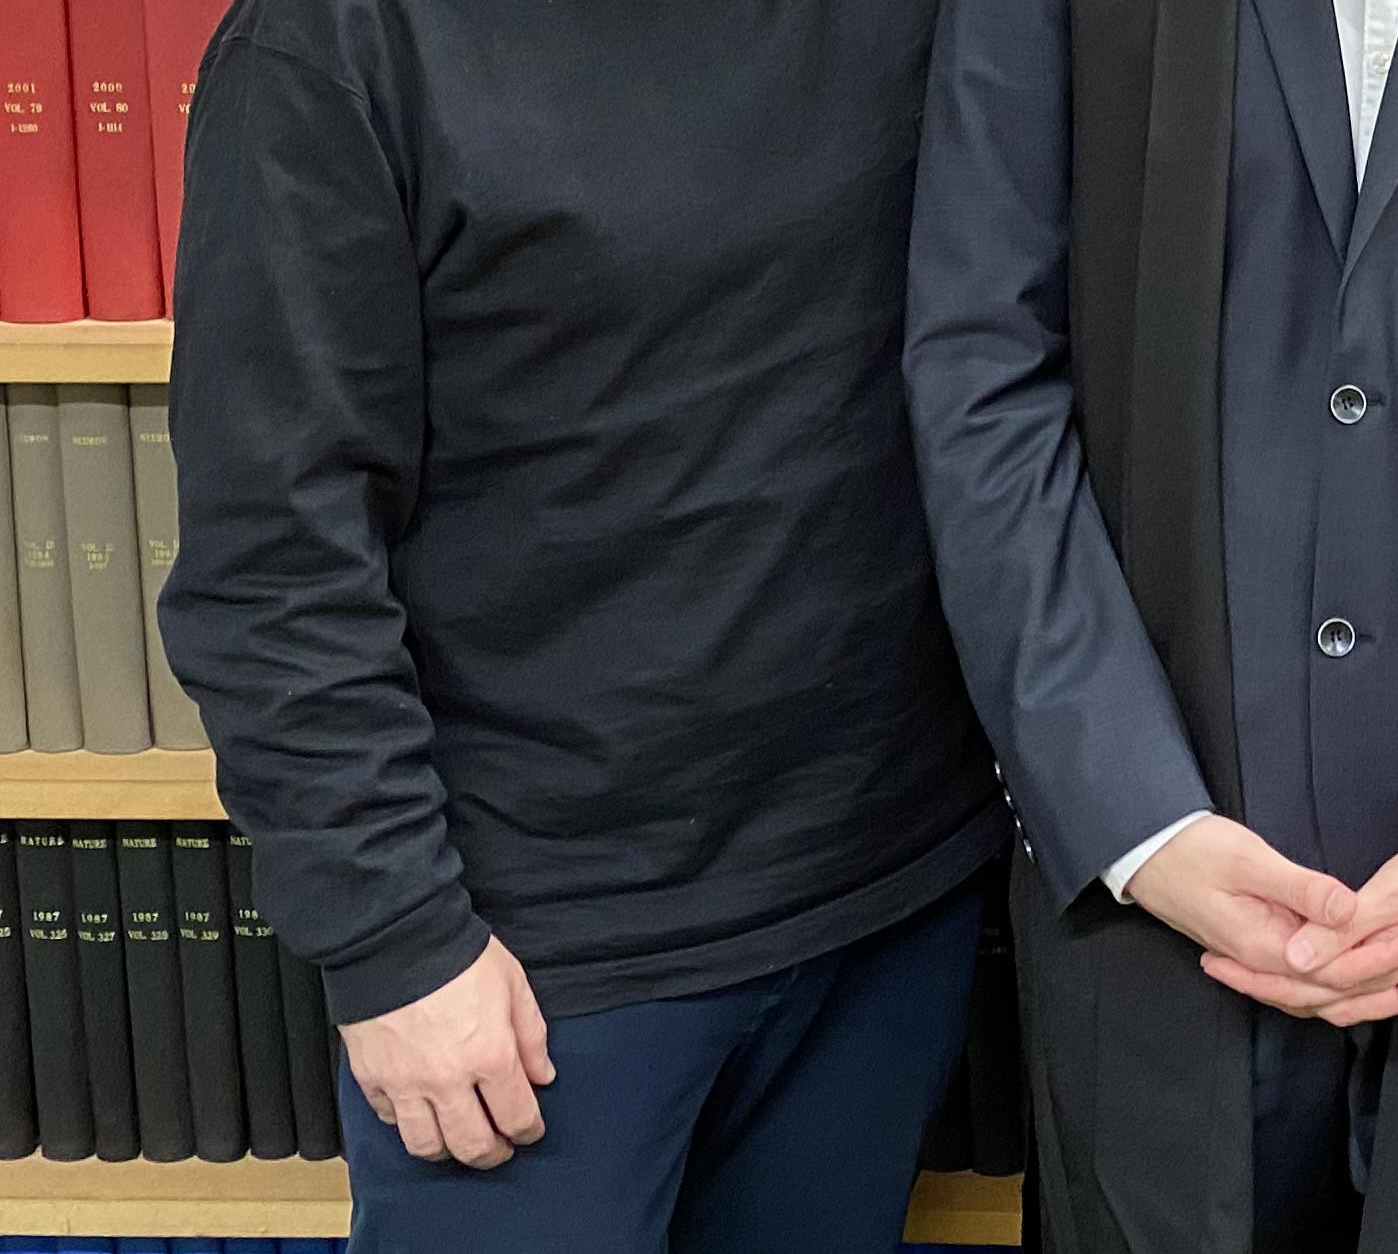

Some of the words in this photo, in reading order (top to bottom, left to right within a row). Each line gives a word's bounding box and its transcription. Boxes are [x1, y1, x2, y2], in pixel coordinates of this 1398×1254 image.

[8, 83, 35, 93] 2001
[21, 837, 64, 846] NATURE
[73, 840, 106, 848] NATURE
[123, 839, 156, 847] NATURE
[176, 838, 209, 848] NATURE
[34, 912, 59, 921] 1987
[82, 914, 107, 923] 1987
[133, 913, 158, 922] 1987
[186, 913, 209, 921] 1987
